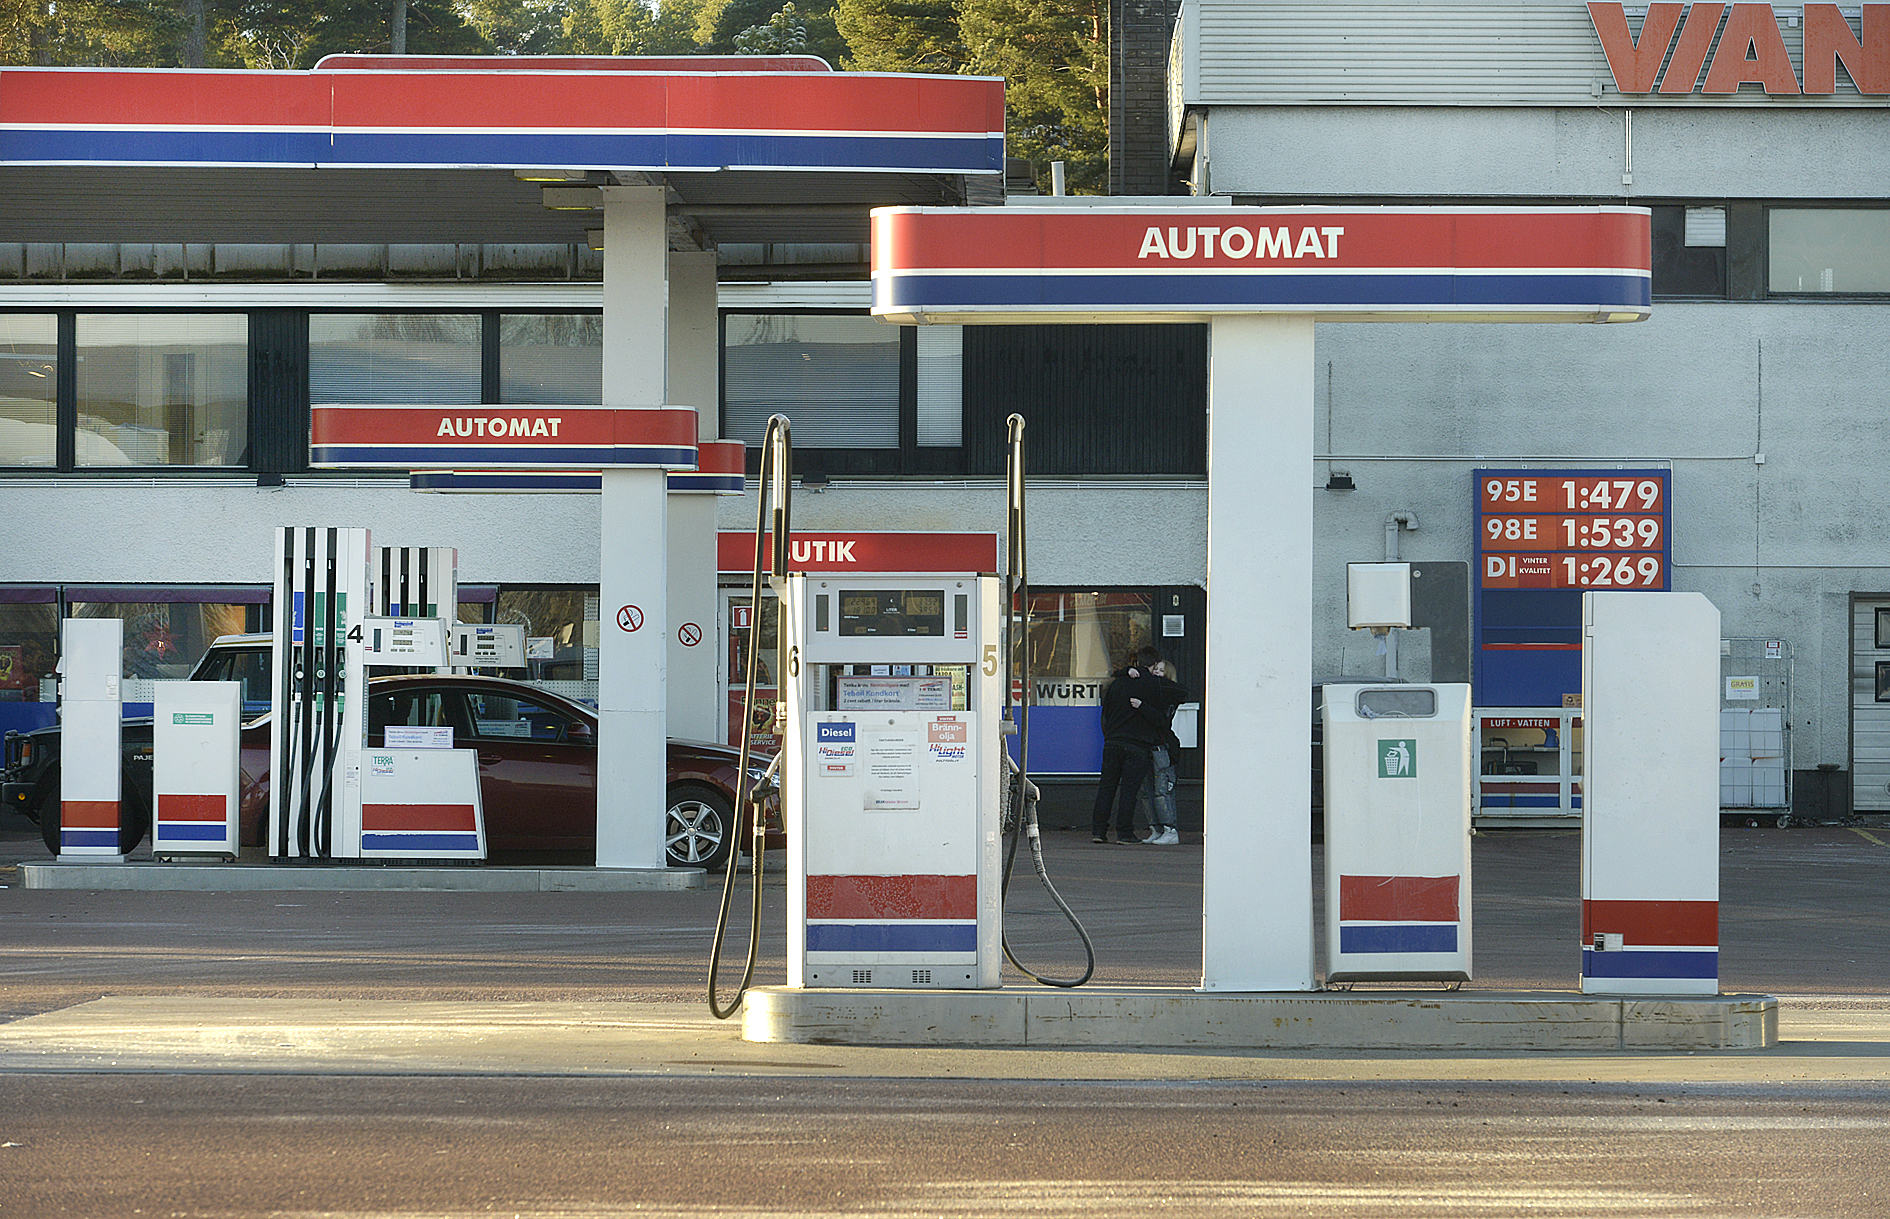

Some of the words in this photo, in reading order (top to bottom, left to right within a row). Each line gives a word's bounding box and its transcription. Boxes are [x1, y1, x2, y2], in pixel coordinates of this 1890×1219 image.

[1138, 226, 1344, 259] AUTOMAT
[437, 418, 562, 437] AUTOMAT
[1486, 480, 1537, 502] 95E
[1562, 480, 1659, 510] 1:479
[1486, 518, 1537, 540] 98E
[1562, 518, 1659, 547] 1:539
[788, 541, 856, 562] UTIK
[1487, 556, 1516, 578] DI
[1562, 556, 1659, 586] 1:269
[347, 624, 364, 644] 4
[788, 645, 799, 678] 6
[982, 644, 998, 676] 5
[741, 696, 777, 706] Bnne
[1036, 684, 1103, 698] WÜRT
[822, 728, 852, 737] Diesel
[939, 732, 955, 741] olja
[930, 744, 965, 757] HiLight
[374, 756, 394, 766] TERRA
